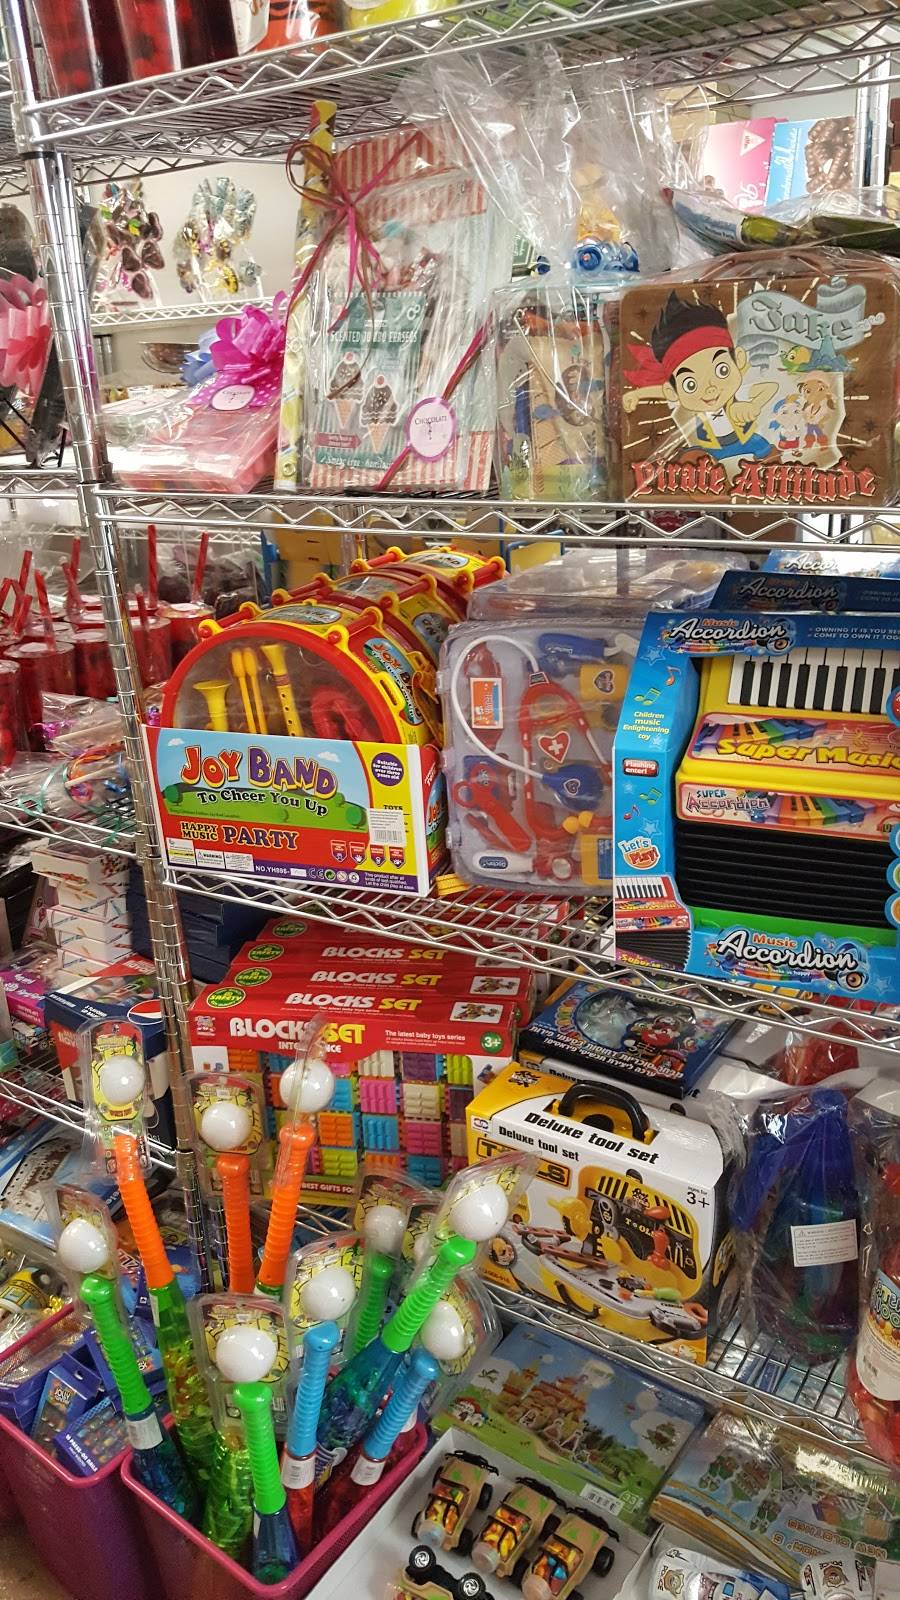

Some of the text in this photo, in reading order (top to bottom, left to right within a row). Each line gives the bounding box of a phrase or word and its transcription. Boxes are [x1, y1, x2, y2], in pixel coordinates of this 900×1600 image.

[750, 298, 854, 341] Jake
[631, 457, 877, 502] Pirate Attitude
[739, 576, 838, 600] Accordion
[670, 617, 786, 642] Accordion
[634, 711, 664, 720] Children
[623, 725, 669, 734] Enlightening
[638, 733, 651, 741] toy
[716, 739, 812, 760] Super
[181, 745, 338, 800] JOY BAND
[624, 760, 656, 770] Flashing
[197, 789, 328, 816] To Cheer You Up
[696, 789, 727, 798] SUPER
[686, 794, 770, 813] Accordion
[180, 821, 298, 850] HAPPY PARTY
[182, 830, 218, 841] MUSIC
[621, 839, 650, 853] Let's
[753, 933, 797, 948] Music
[321, 946, 448, 960] BLOCKS SET
[717, 930, 857, 970] Accordion
[310, 970, 443, 986] BLOCKS SET
[285, 992, 422, 1011] BLOCKS SET
[324, 1022, 365, 1045] SET
[398, 1030, 414, 1038] latest
[415, 1031, 431, 1040] baby
[432, 1033, 446, 1041] toys
[484, 1037, 501, 1048] 3+
[498, 1126, 580, 1163] Deluxe tool set
[524, 1112, 660, 1165] Deluxe tool set
[301, 1183, 321, 1191] BEST
[322, 1184, 344, 1192] GIFTS
[686, 1191, 710, 1209] 3+
